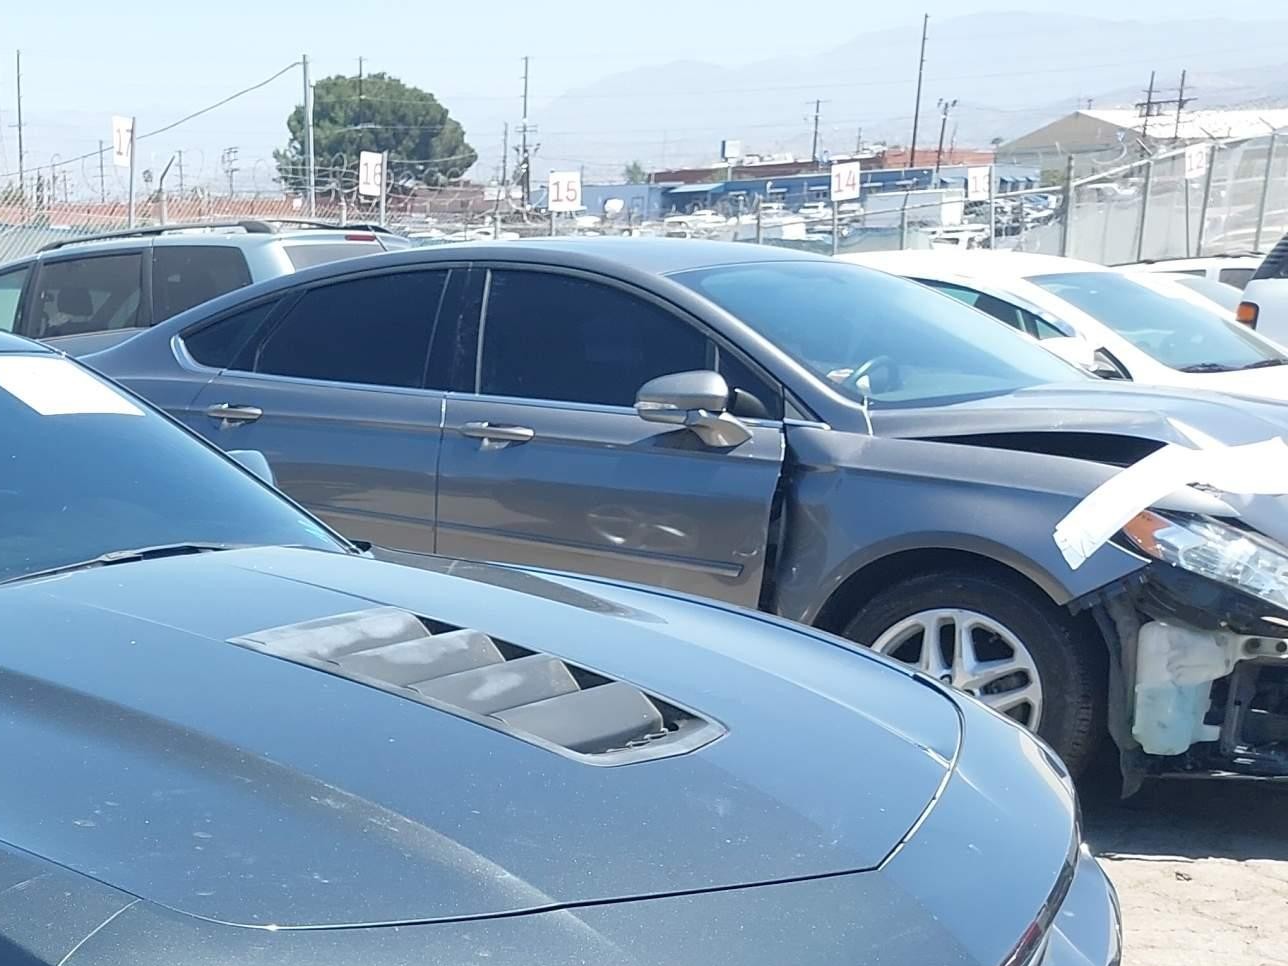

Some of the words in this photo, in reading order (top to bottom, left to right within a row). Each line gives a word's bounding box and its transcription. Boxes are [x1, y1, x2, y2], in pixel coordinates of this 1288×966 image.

[1187, 151, 1204, 172] 12
[362, 162, 382, 186] 16
[833, 170, 857, 193] 14
[552, 181, 577, 202] 15
